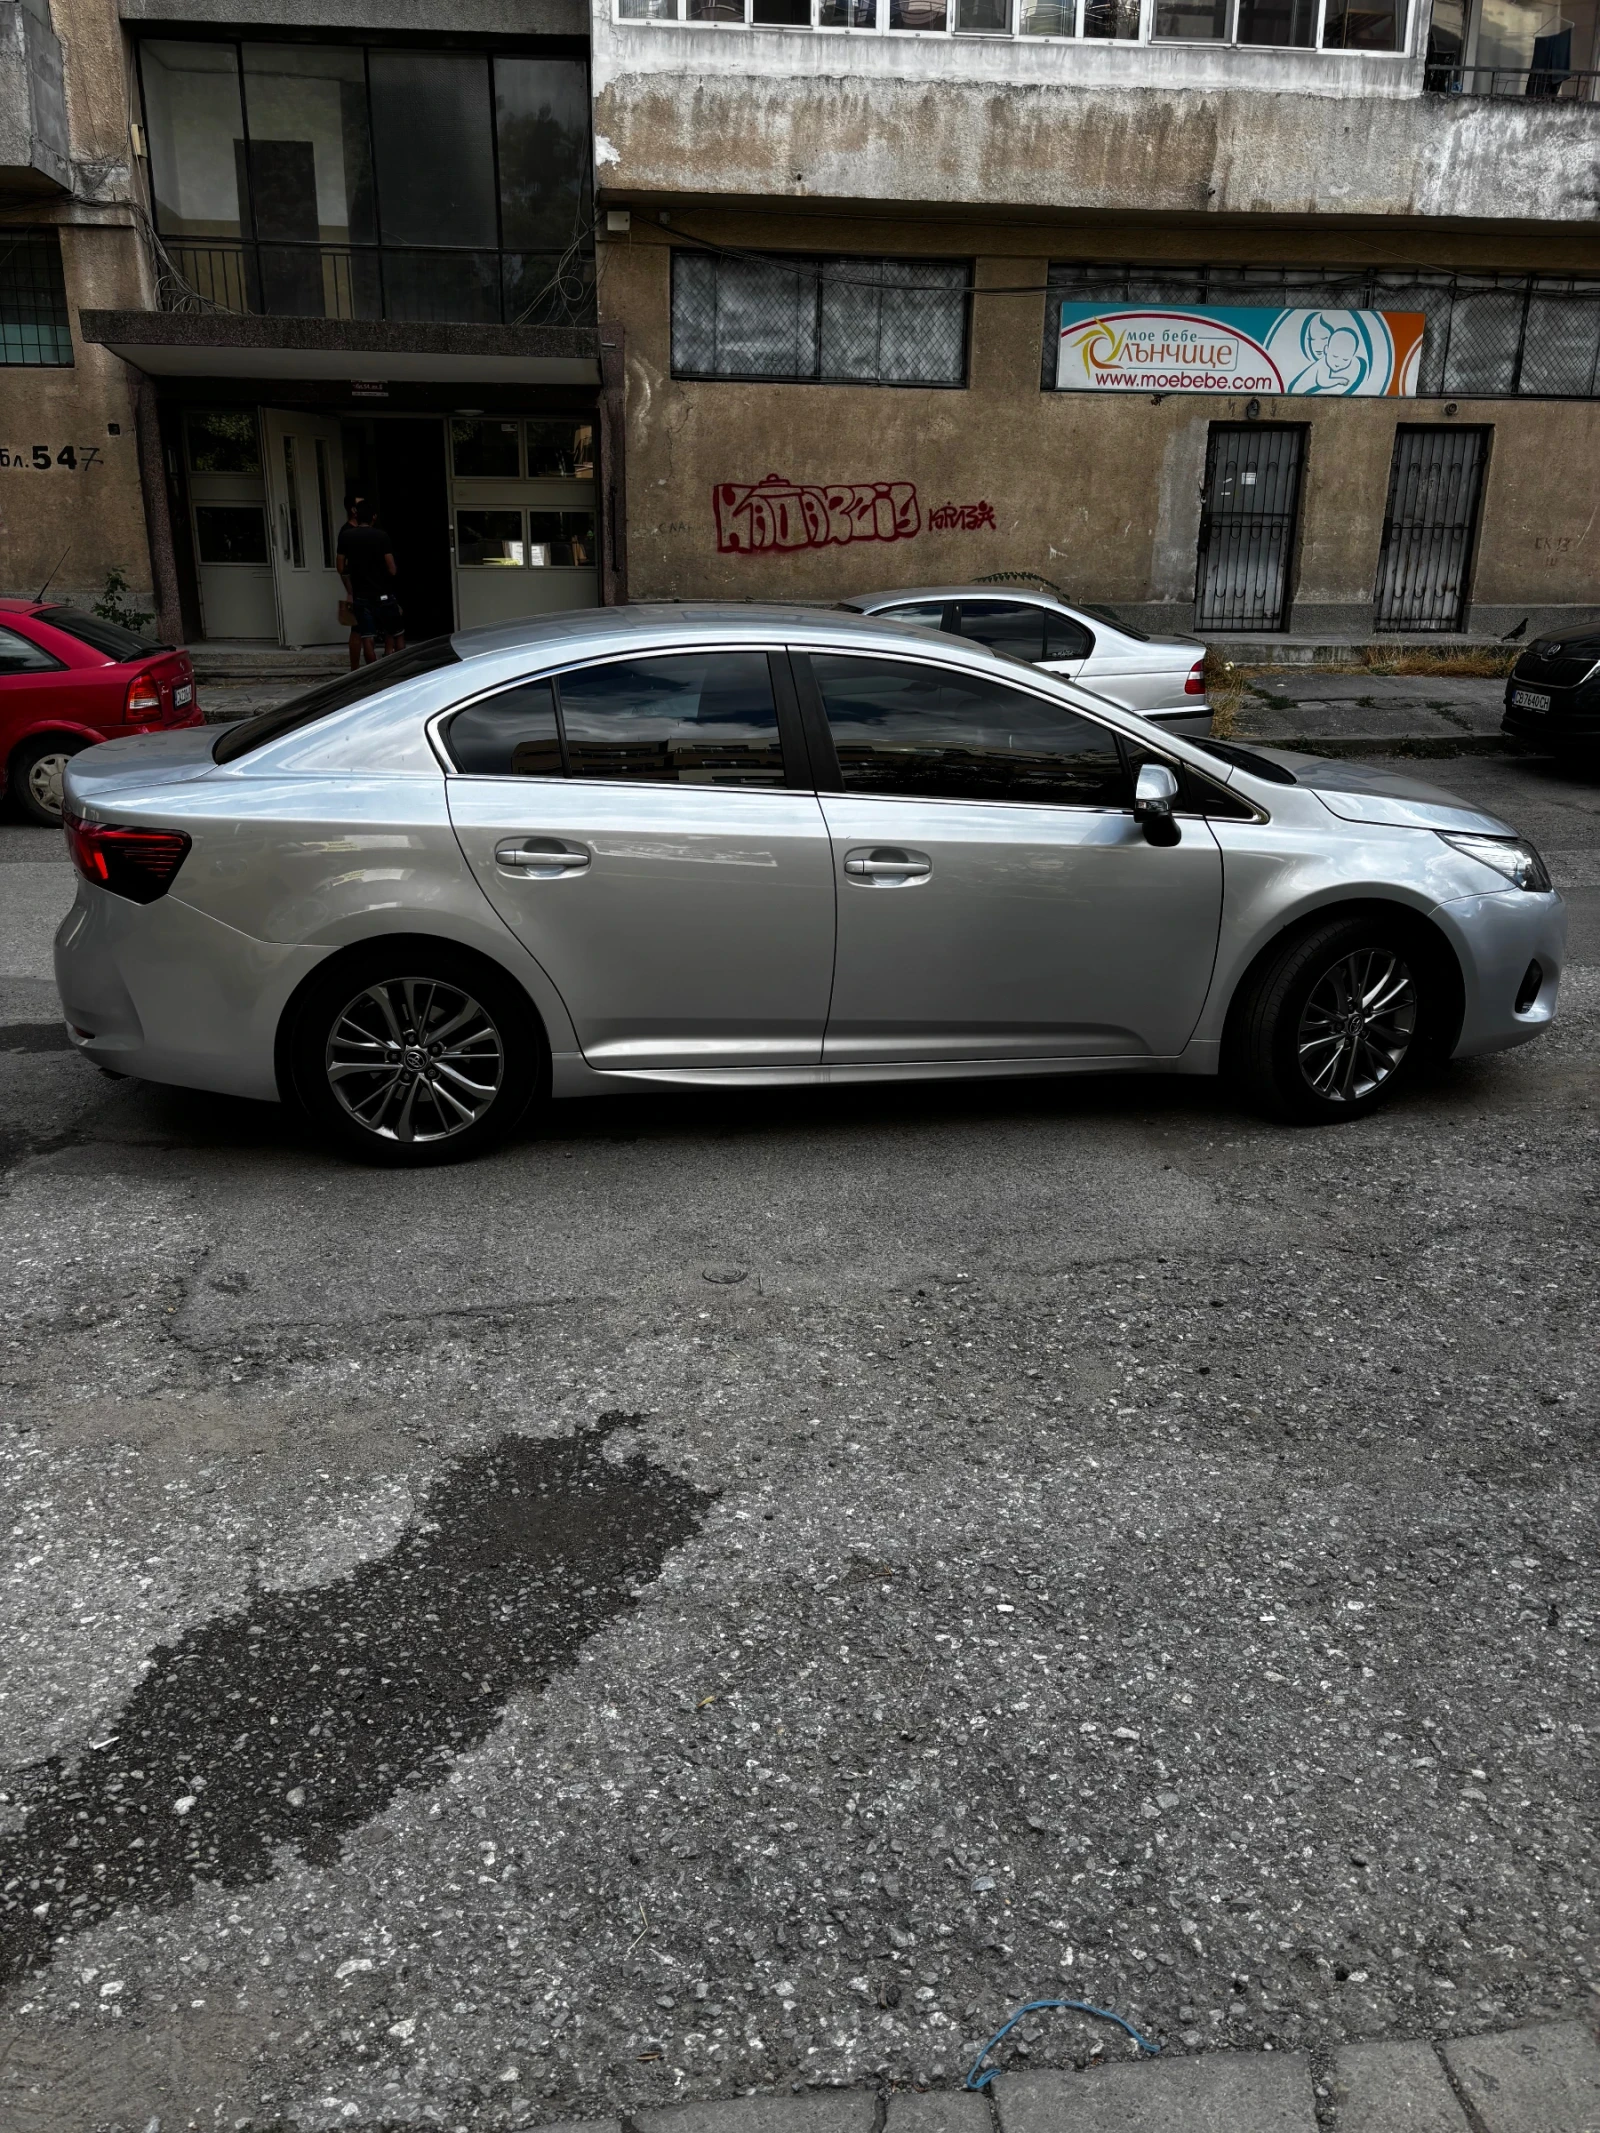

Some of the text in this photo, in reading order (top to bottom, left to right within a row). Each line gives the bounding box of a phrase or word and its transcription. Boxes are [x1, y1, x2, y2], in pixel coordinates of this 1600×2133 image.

[1127, 329, 1198, 343] мое бебе
[1095, 371, 1272, 390] www.moebebe.com
